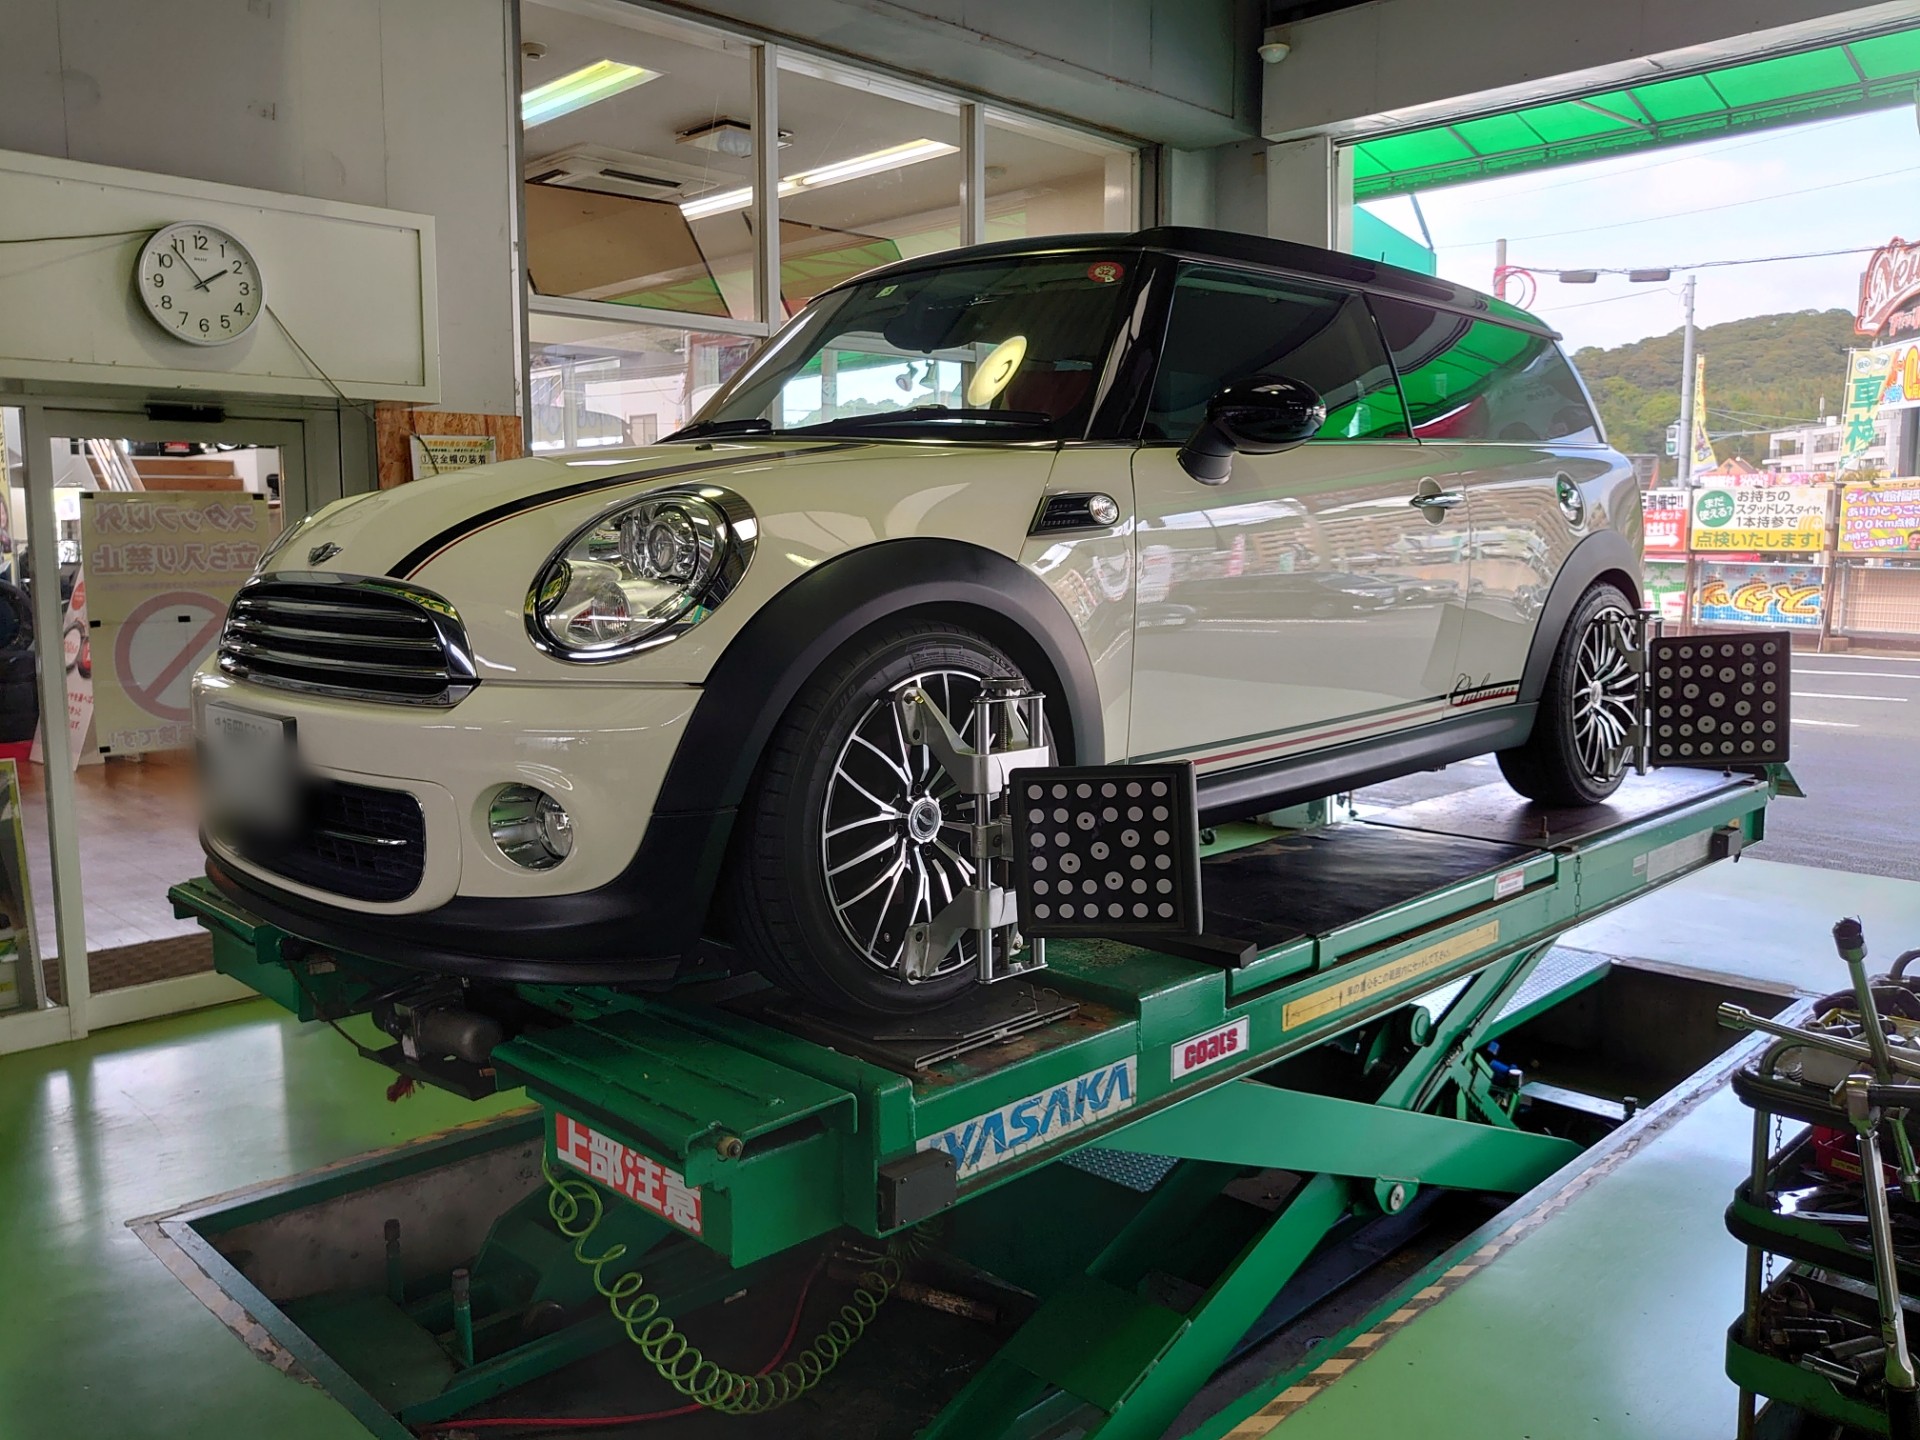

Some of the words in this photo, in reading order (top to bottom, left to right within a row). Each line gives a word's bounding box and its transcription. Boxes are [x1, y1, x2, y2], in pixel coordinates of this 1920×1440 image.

[173, 238, 185, 253] 11
[193, 235, 209, 250] 12
[219, 244, 225, 258] 1
[157, 253, 173, 268] 10
[232, 260, 243, 274] 2
[153, 273, 164, 288] 9
[239, 282, 249, 296] 3
[161, 295, 172, 310] 8
[233, 302, 245, 316] 4
[179, 311, 189, 325] 7
[199, 318, 210, 332] 6
[220, 314, 231, 329] 5
[1845, 374, 1886, 452] 車検
[1704, 496, 1725, 508] まだ
[1737, 491, 1790, 503] お持ちの
[1699, 505, 1733, 521] 使える?
[1737, 516, 1798, 529] 1本持参で
[1696, 532, 1820, 548] 点検いたします!
[931, 1063, 1132, 1173] YASAKA
[557, 1117, 701, 1232] 上部注意
